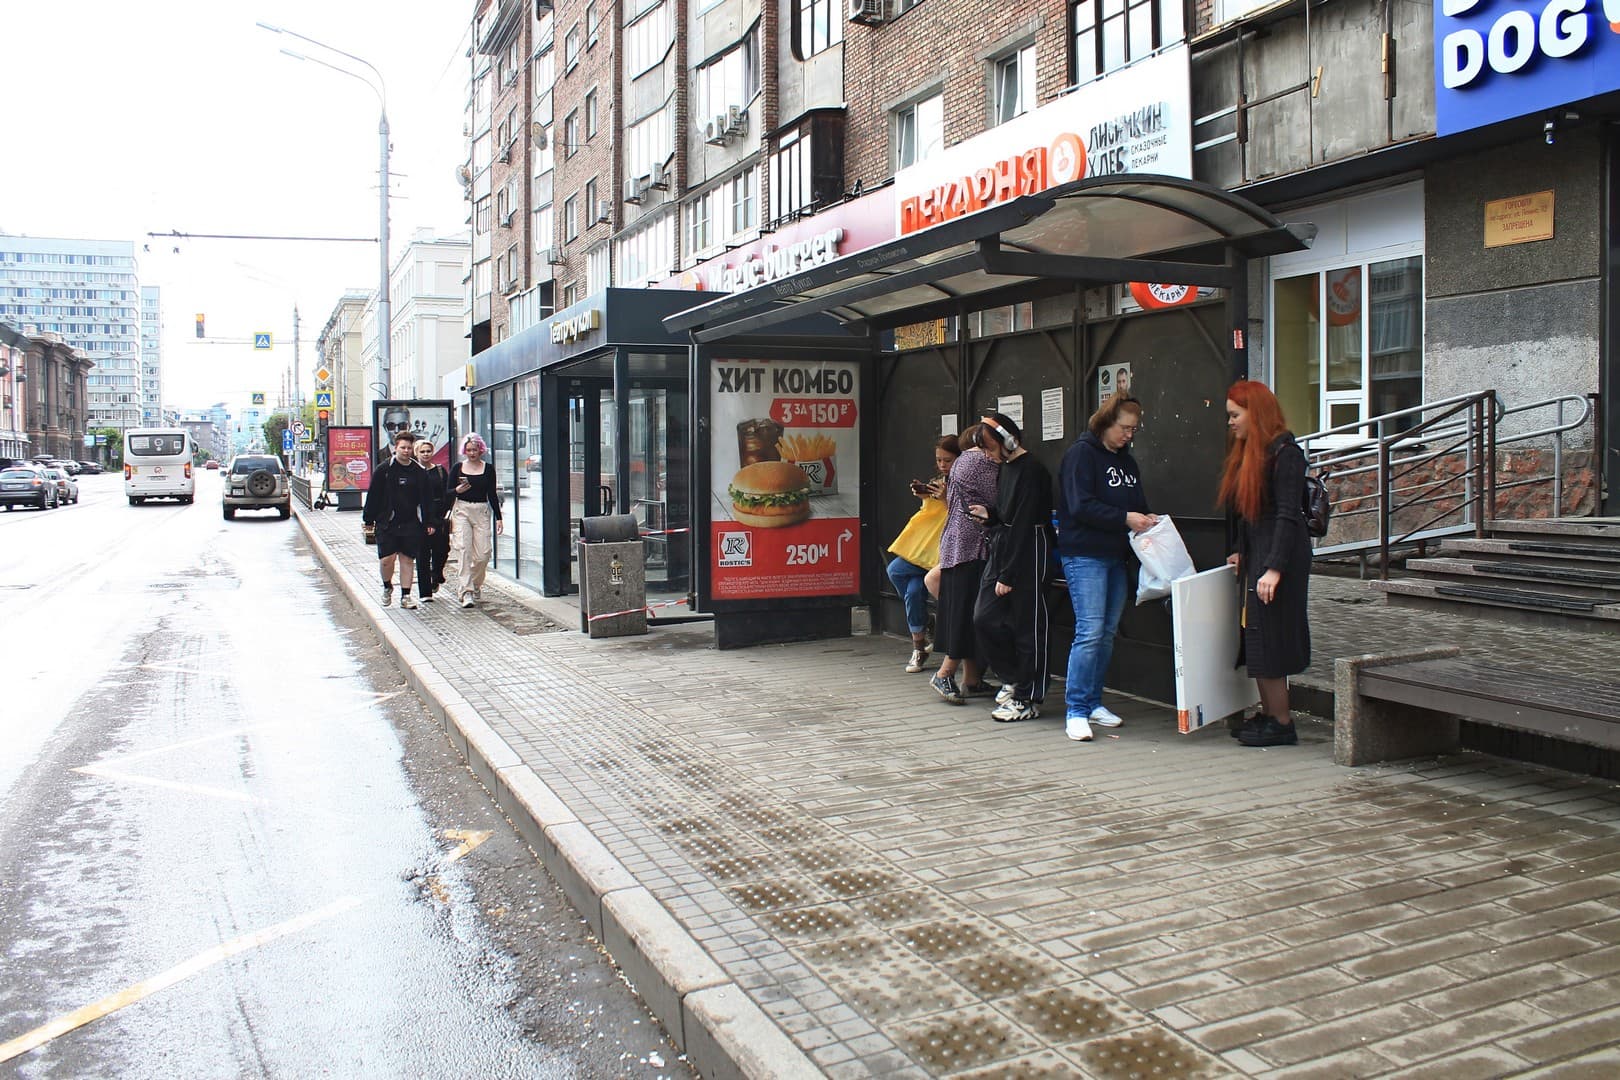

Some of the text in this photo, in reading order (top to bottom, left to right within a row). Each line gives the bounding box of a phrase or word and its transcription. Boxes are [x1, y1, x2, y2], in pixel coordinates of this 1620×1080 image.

[1443, 0, 1588, 89] DOG
[1088, 146, 1128, 178] ХЛЕБ
[902, 147, 1048, 235] ПЕКАРНЯ
[709, 227, 844, 294] Magic burger
[718, 368, 853, 394] ХИТ КОМБО
[781, 403, 793, 423] 3
[809, 403, 839, 423] 150
